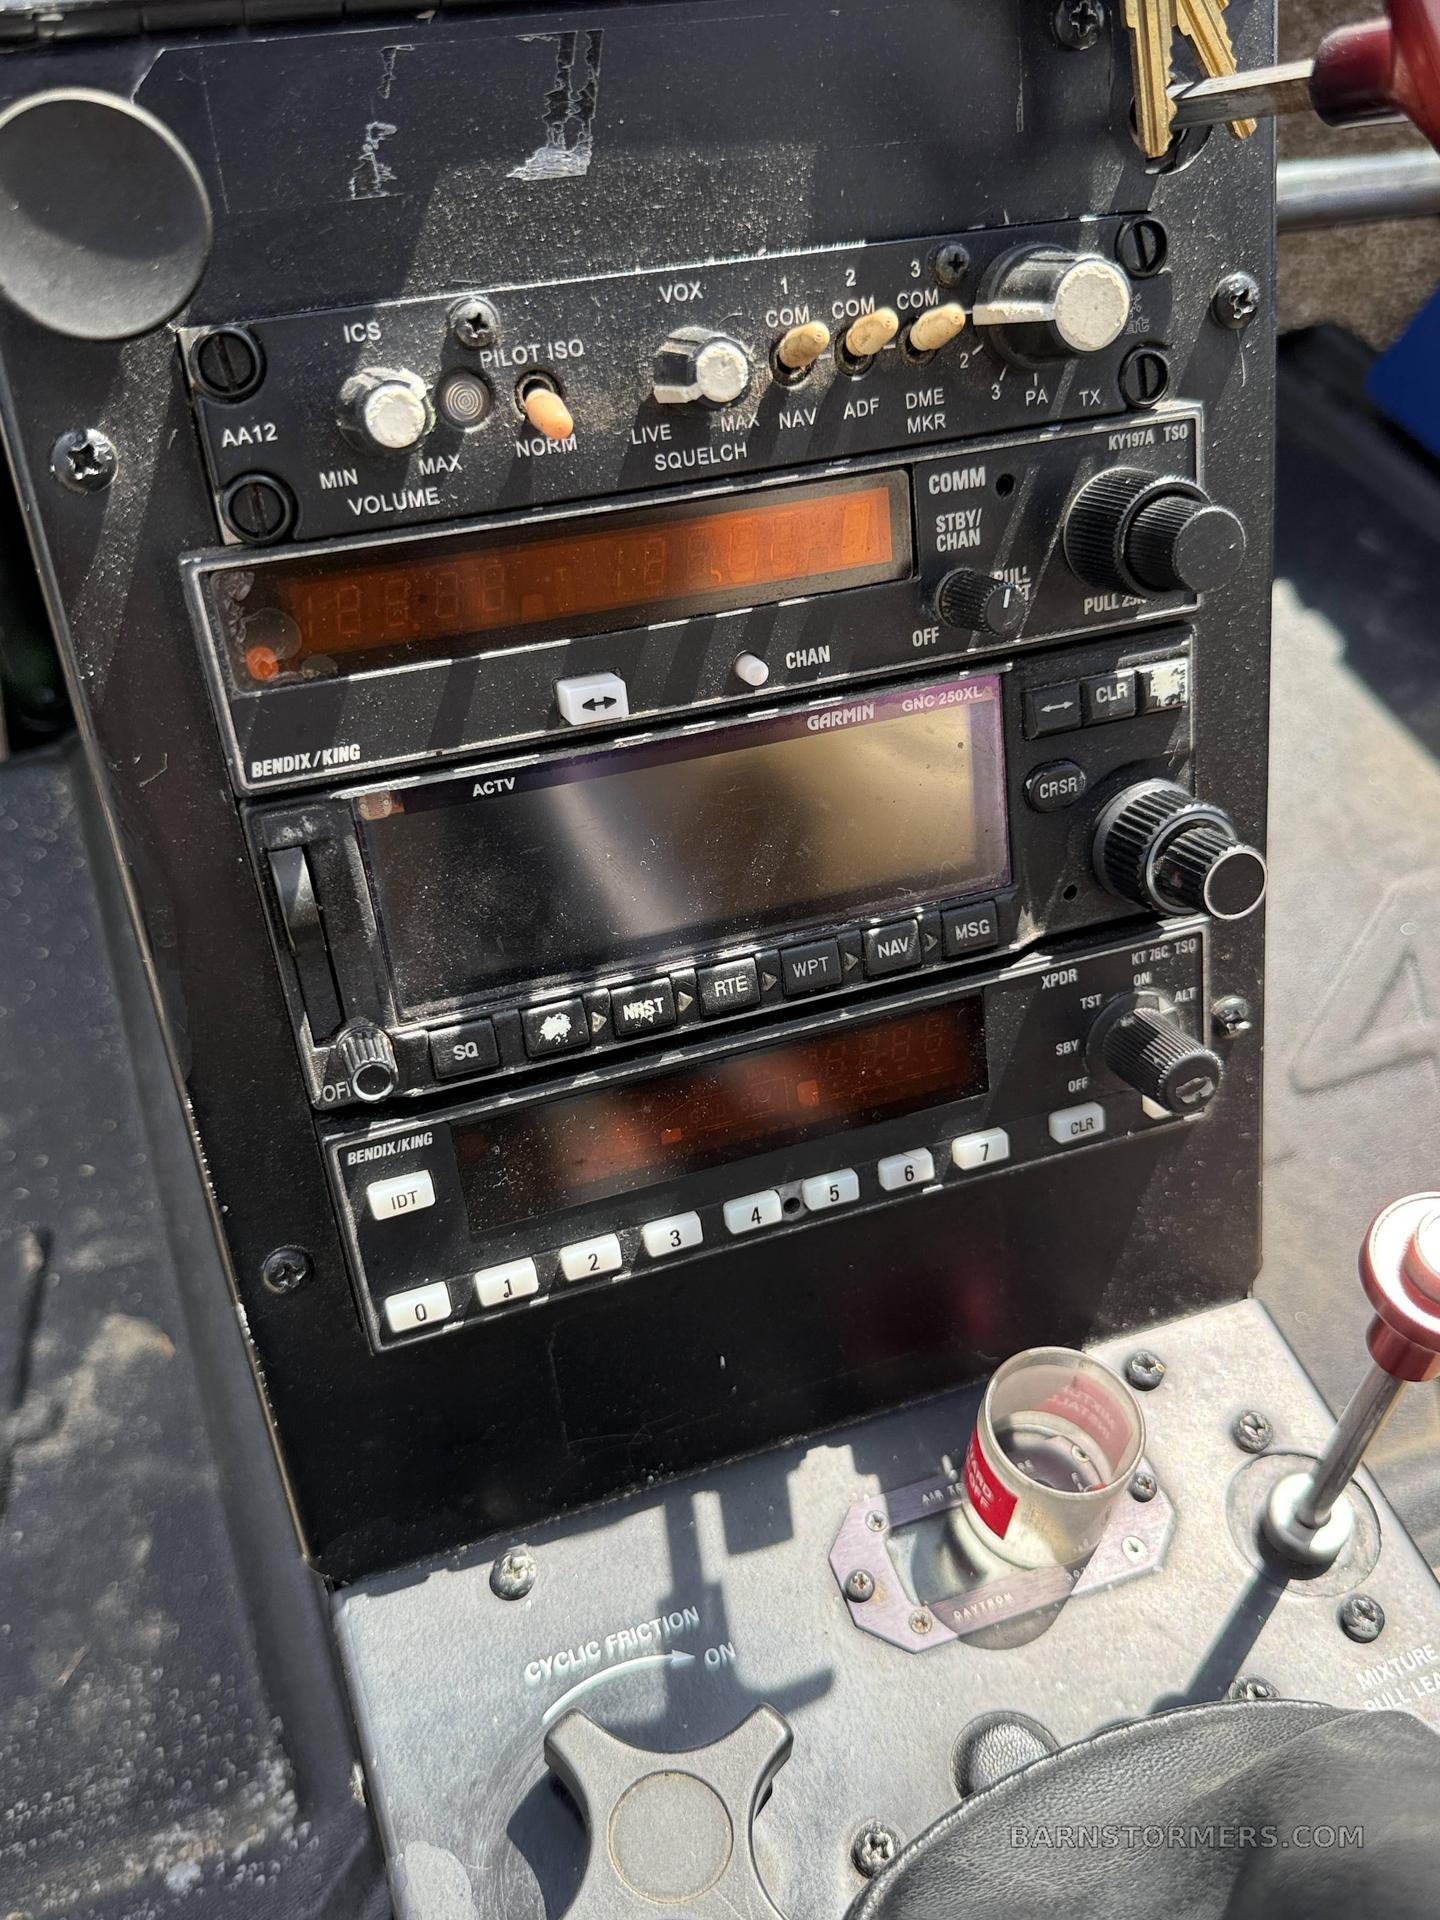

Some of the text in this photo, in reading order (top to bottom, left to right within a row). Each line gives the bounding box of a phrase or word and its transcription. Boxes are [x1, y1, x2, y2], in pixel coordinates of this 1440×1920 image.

[845, 268, 857, 287] 2
[910, 260, 921, 278] 3
[658, 281, 703, 304] VOX
[780, 275, 788, 294] 1
[831, 296, 875, 320] COM
[896, 288, 939, 311] COM
[765, 305, 811, 328] COM
[343, 322, 382, 344] ICS
[480, 338, 584, 369] PILOT ISO
[959, 353, 969, 369] 2
[905, 387, 945, 409] DME
[991, 384, 1001, 400] 3
[1025, 390, 1049, 406] PA
[1079, 388, 1101, 405] TX
[778, 407, 818, 430] NAV
[843, 398, 880, 420] ADF
[720, 412, 760, 433] MAX
[907, 412, 946, 434] MKR
[221, 422, 279, 448] AA12
[631, 424, 672, 445] LIVE
[1108, 424, 1188, 451] KY197A TSO
[515, 435, 578, 458] NORM
[654, 441, 748, 472] SQUELCH
[418, 453, 463, 476] MAX
[319, 468, 359, 490] MIN
[928, 466, 986, 495] COMM
[348, 487, 440, 517] VOLUME
[936, 507, 983, 533] STBY/
[936, 528, 981, 552] CHAN
[1084, 593, 1119, 615] PULL
[912, 626, 940, 647] OFF
[785, 645, 831, 670] CHAN
[1095, 682, 1128, 705] CLR
[807, 686, 983, 731] GARMIN GNC 250XL
[251, 743, 361, 779] BENDIX/KING
[472, 777, 516, 798] ACTV
[1039, 778, 1077, 799] CRSR
[954, 918, 991, 942] MSG
[877, 936, 910, 959] NAV
[1131, 951, 1147, 966] KT
[1174, 938, 1196, 954] TSO
[792, 956, 829, 979] WPT
[713, 975, 748, 999] RTE
[1041, 968, 1077, 990] XPDR
[1133, 971, 1151, 987] ON
[1080, 993, 1101, 1010] TST
[1174, 987, 1196, 1003] ALT
[453, 1041, 479, 1062] SQ
[1055, 1039, 1080, 1056] SBY
[1068, 1076, 1088, 1093] OFF
[1070, 1117, 1095, 1135] CLR
[347, 1131, 433, 1166] BENDIX/KING
[979, 1143, 990, 1162] 7
[904, 1164, 915, 1182] 6
[390, 1190, 419, 1211] IDT
[829, 1184, 840, 1202] 5
[751, 1206, 762, 1225] 4
[669, 1230, 682, 1248] 3
[587, 1253, 601, 1272] 2
[922, 1488, 944, 1506] AIR
[524, 1605, 700, 1684] CYCLIC FRICTION
[704, 1641, 737, 1668] ON
[1356, 1644, 1440, 1691] MIXTURE
